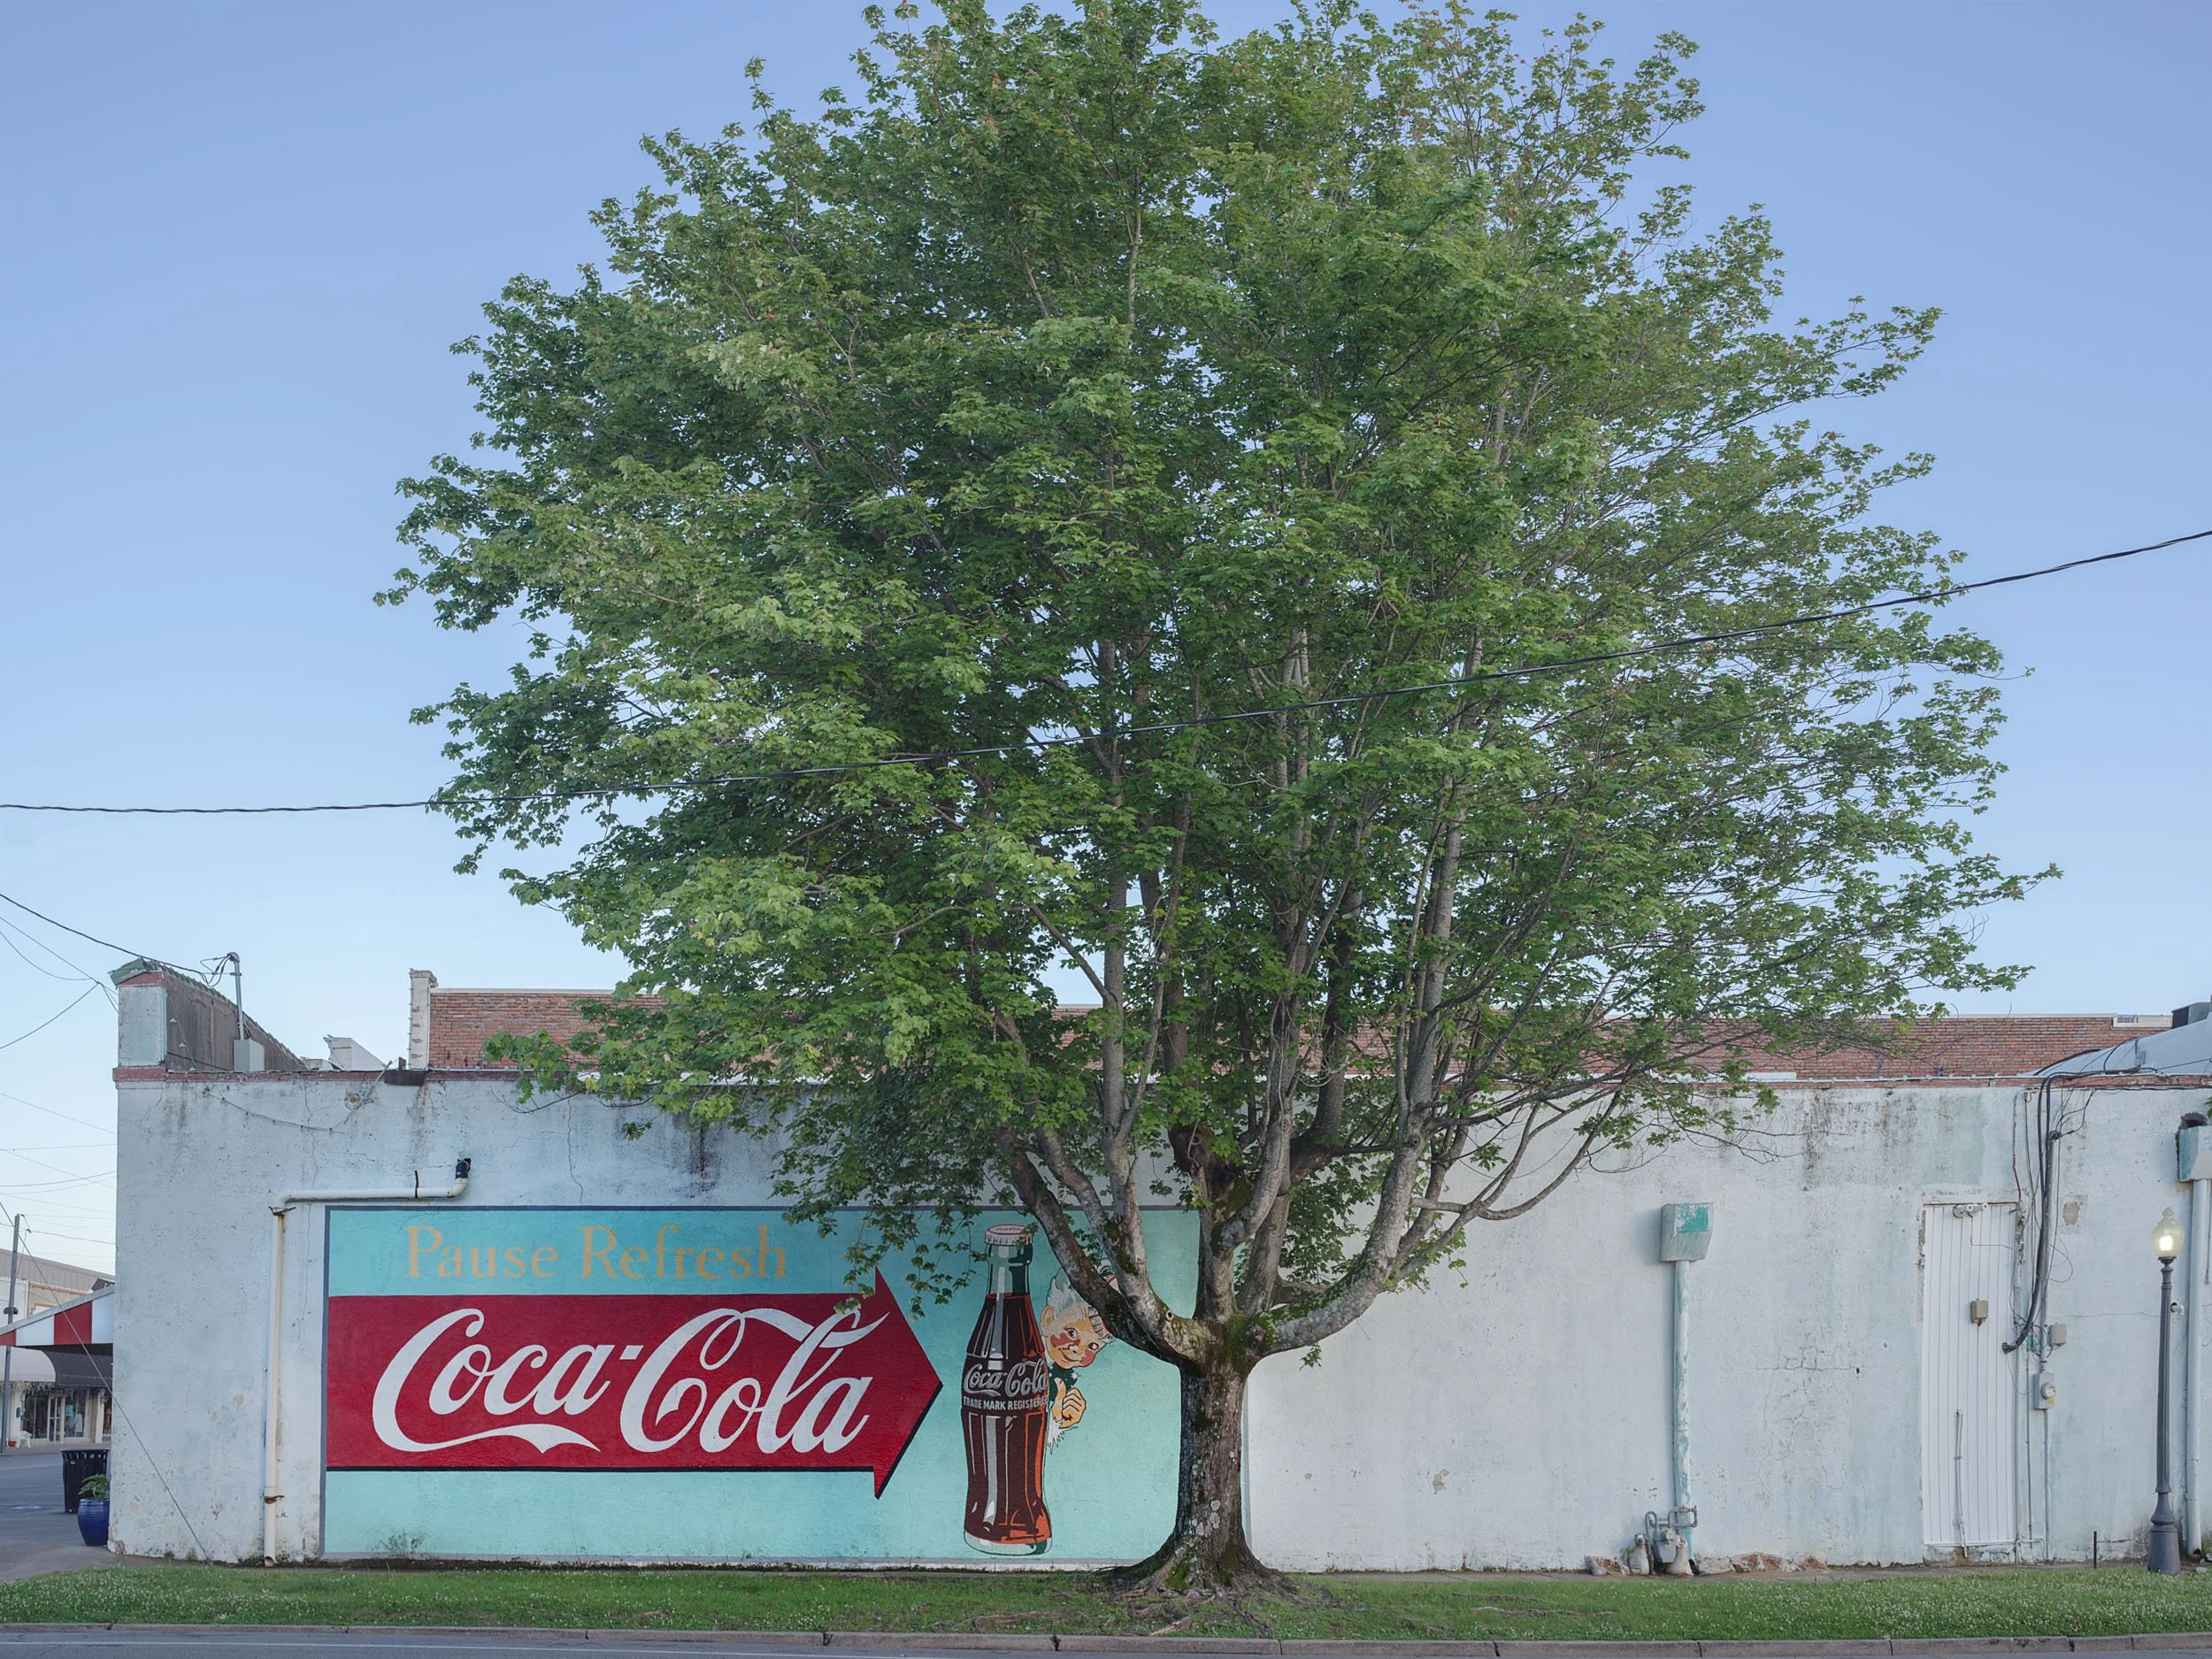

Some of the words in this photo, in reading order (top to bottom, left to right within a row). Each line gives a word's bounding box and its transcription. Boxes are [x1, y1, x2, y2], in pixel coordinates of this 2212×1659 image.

[404, 1225, 558, 1279] Pause
[578, 1224, 789, 1279] Refresh
[372, 1308, 890, 1454] Coca-Cola
[964, 1359, 1048, 1397] Coca-Cola
[963, 1396, 982, 1409] TRADE
[983, 1401, 1007, 1410] MARK
